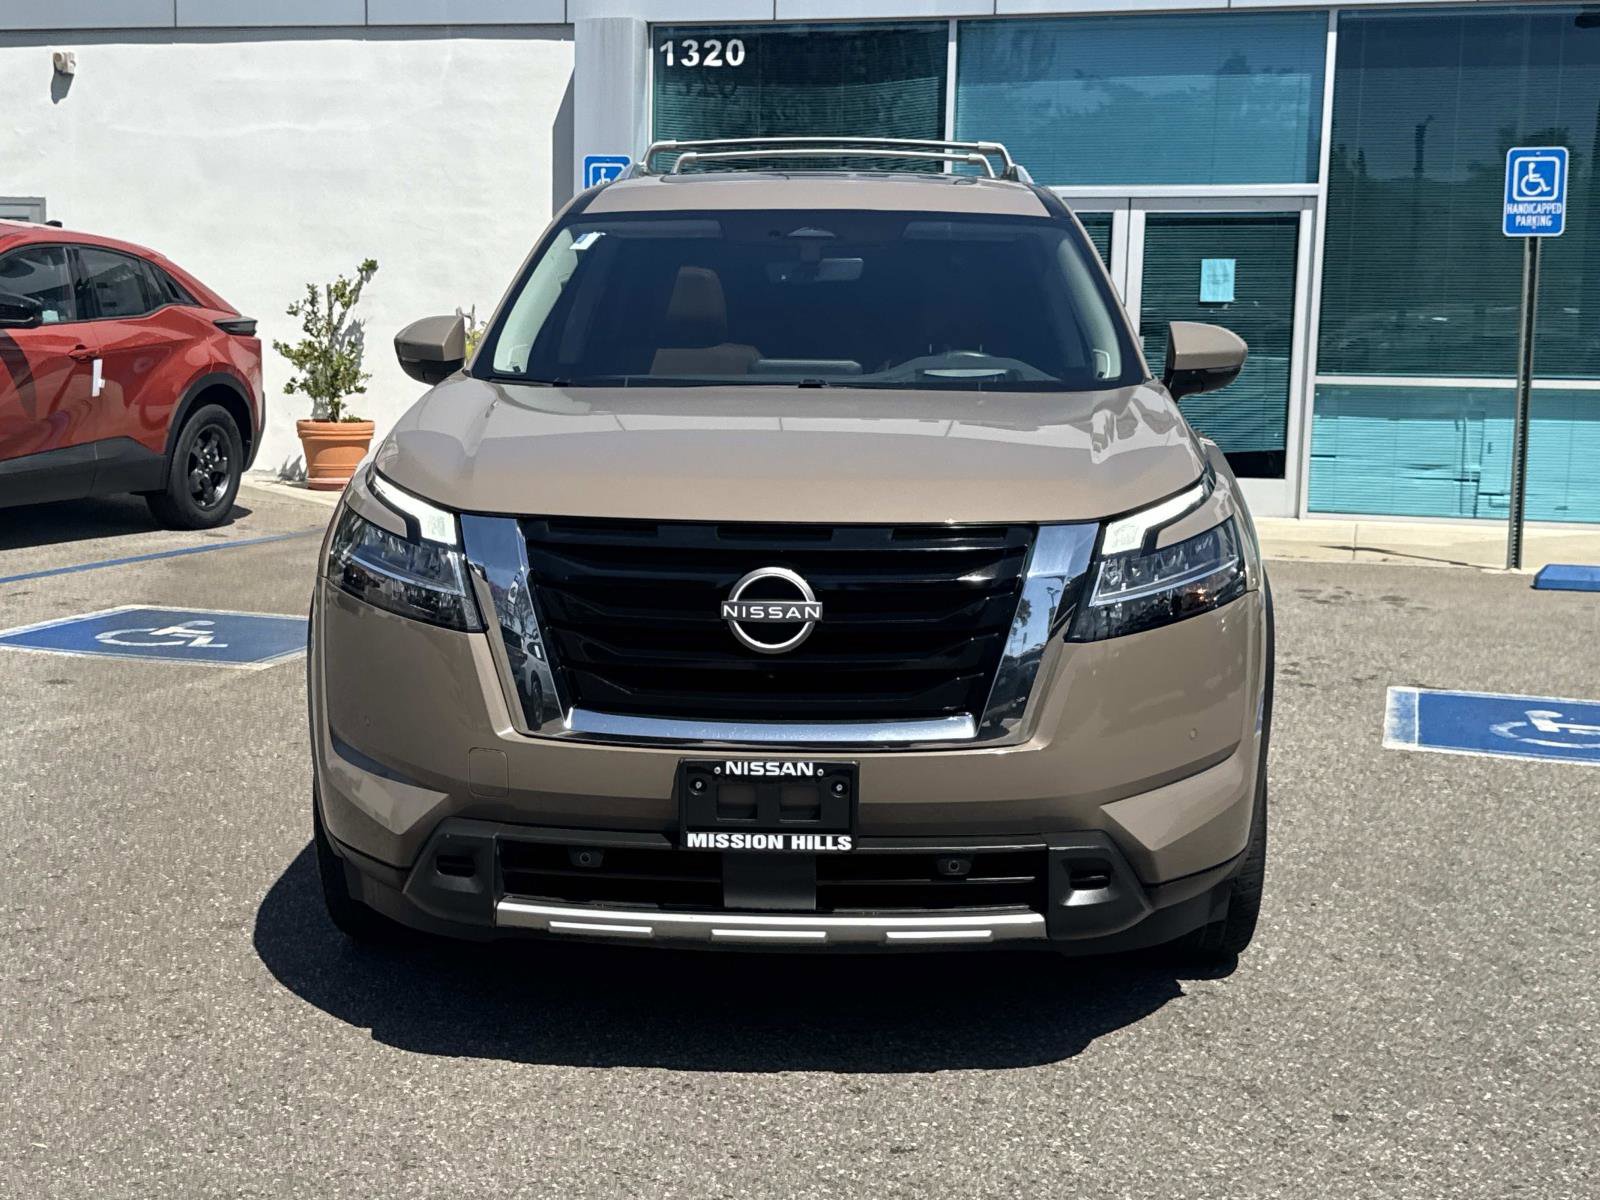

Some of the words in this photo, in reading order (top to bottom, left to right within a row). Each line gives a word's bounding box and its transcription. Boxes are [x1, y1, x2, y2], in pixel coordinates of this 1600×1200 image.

[660, 39, 745, 67] 1320
[1507, 203, 1562, 214] HANDICAPPED
[1515, 215, 1552, 226] PARKING
[723, 605, 820, 619] NISSAN
[725, 761, 814, 776] NISSAN
[687, 833, 783, 849] MISSION
[791, 835, 852, 850] HILLS
